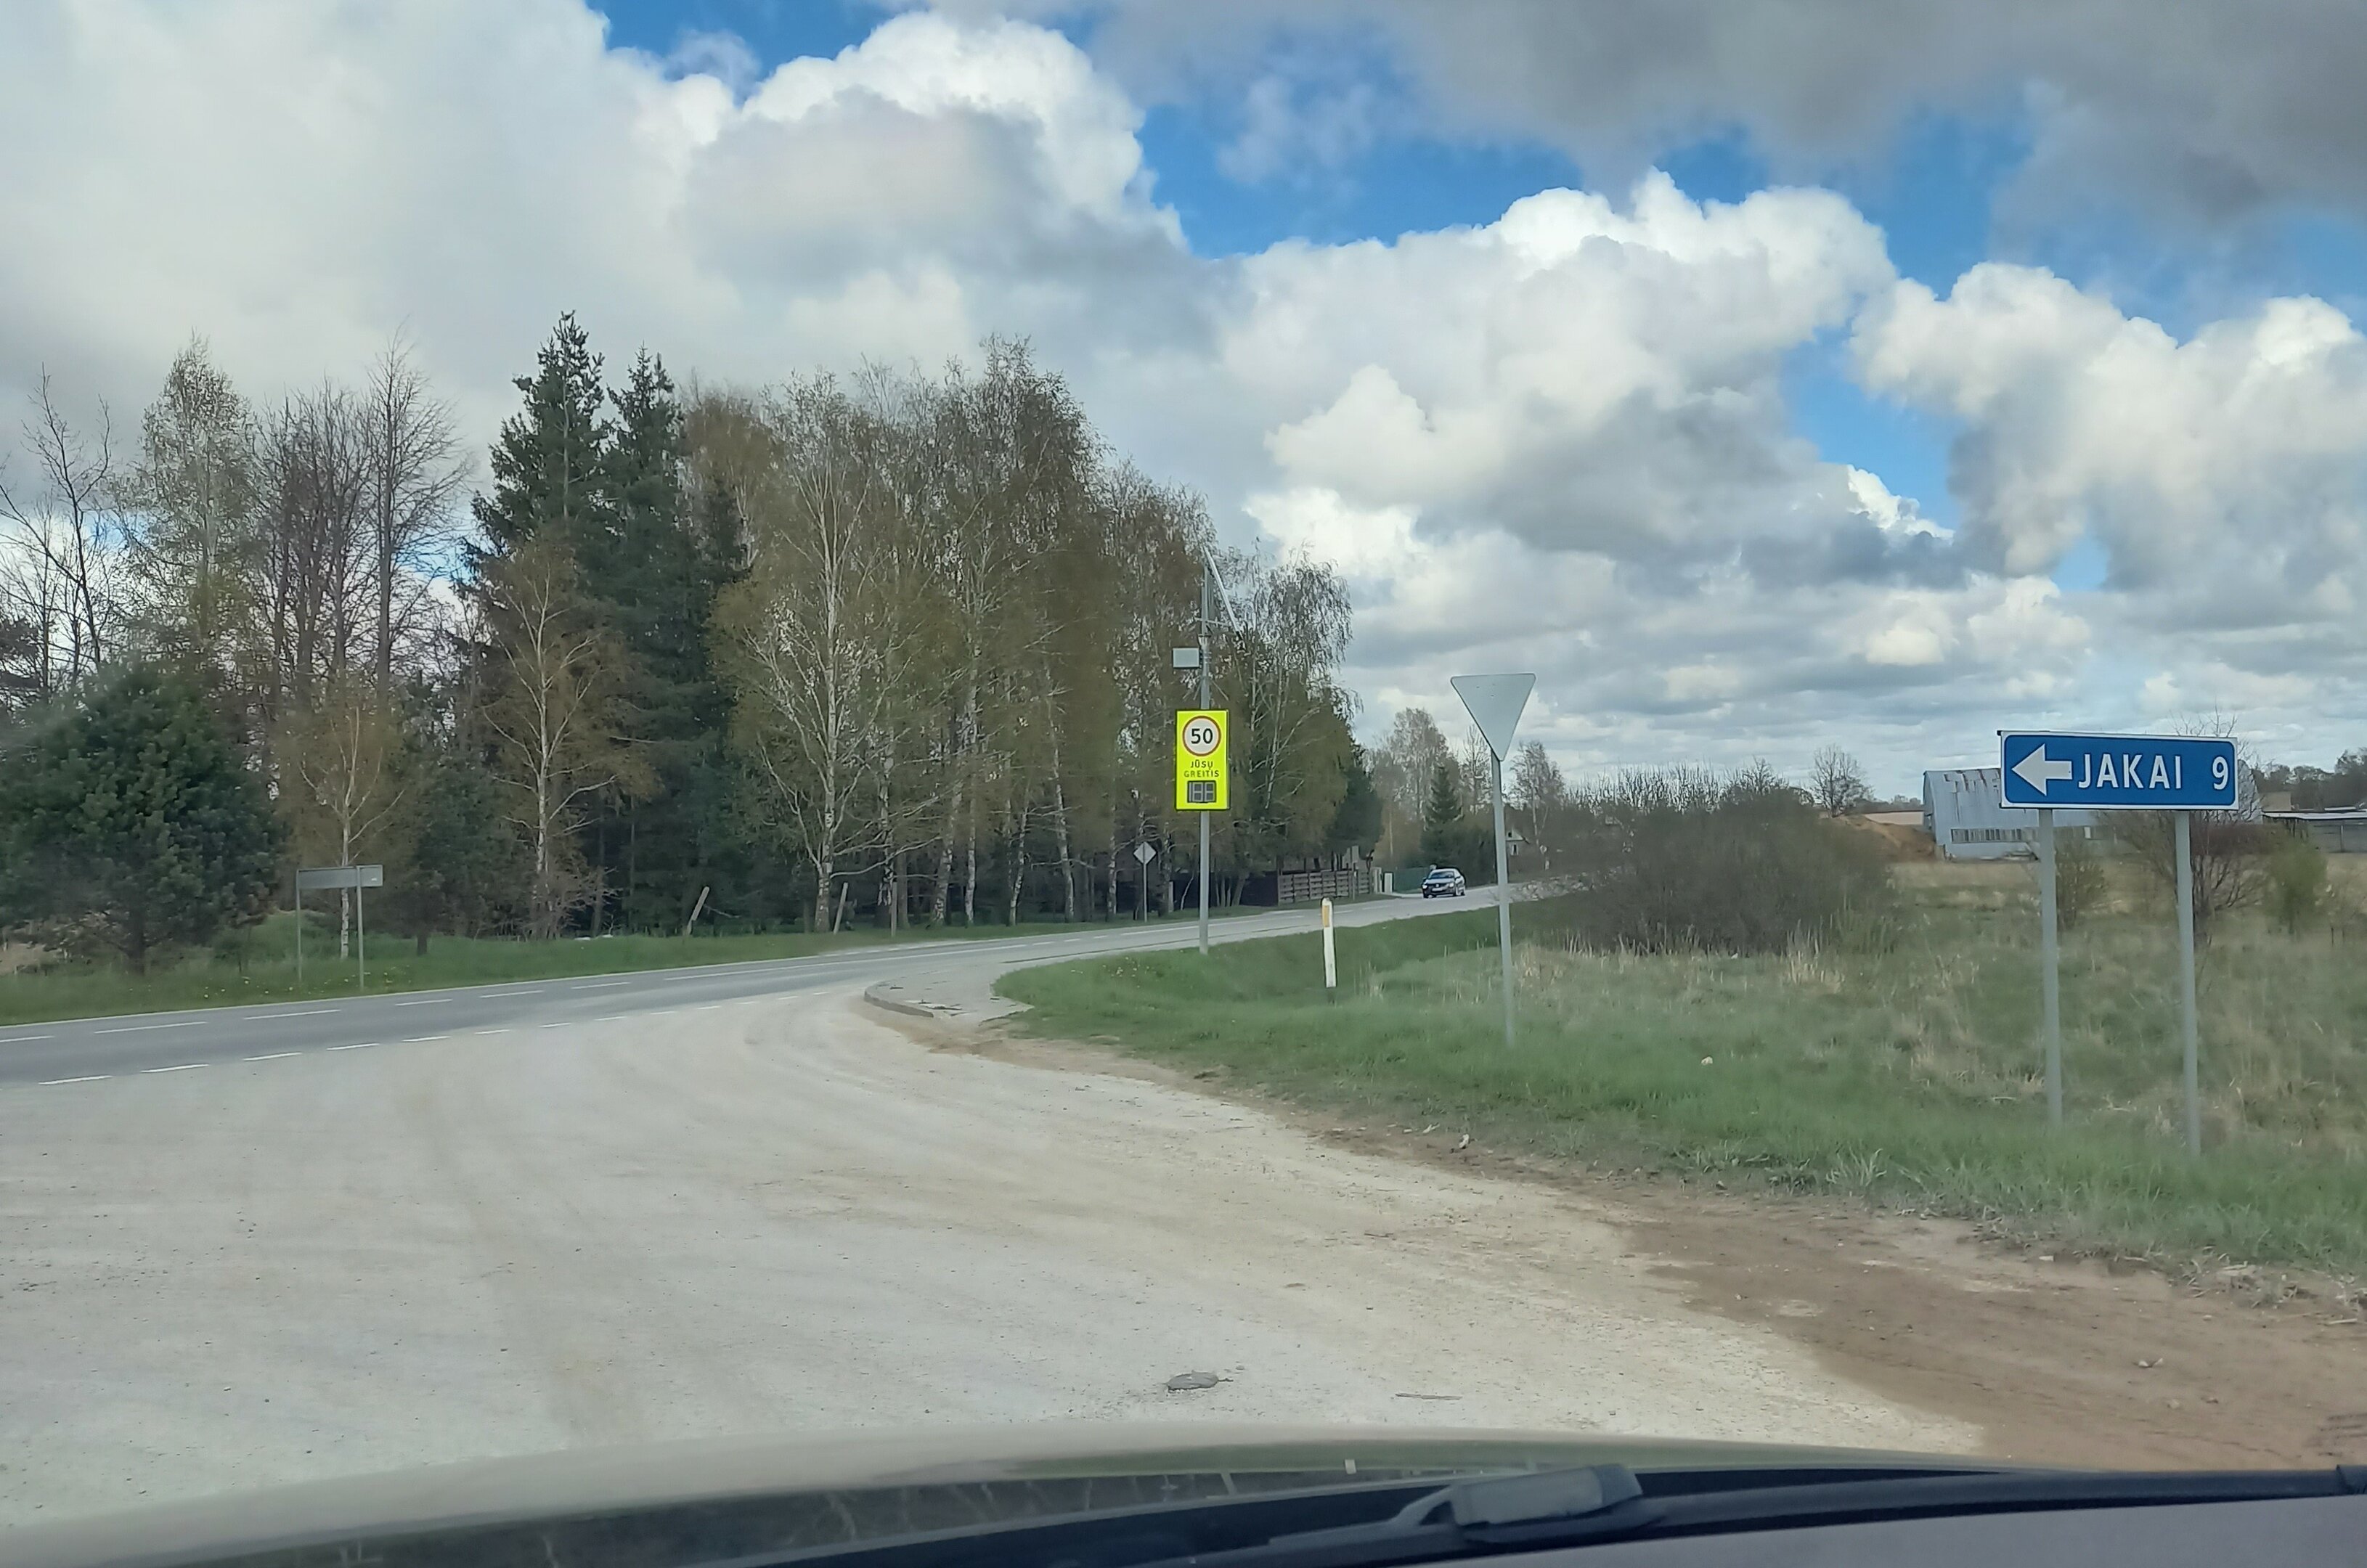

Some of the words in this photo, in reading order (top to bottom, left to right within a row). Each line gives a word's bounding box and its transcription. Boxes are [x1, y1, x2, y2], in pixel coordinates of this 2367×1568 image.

[1191, 728, 1213, 744] 50
[1190, 759, 1213, 770] JŪSŲ
[2078, 754, 2182, 789] JAKAI
[2212, 756, 2229, 791] 9
